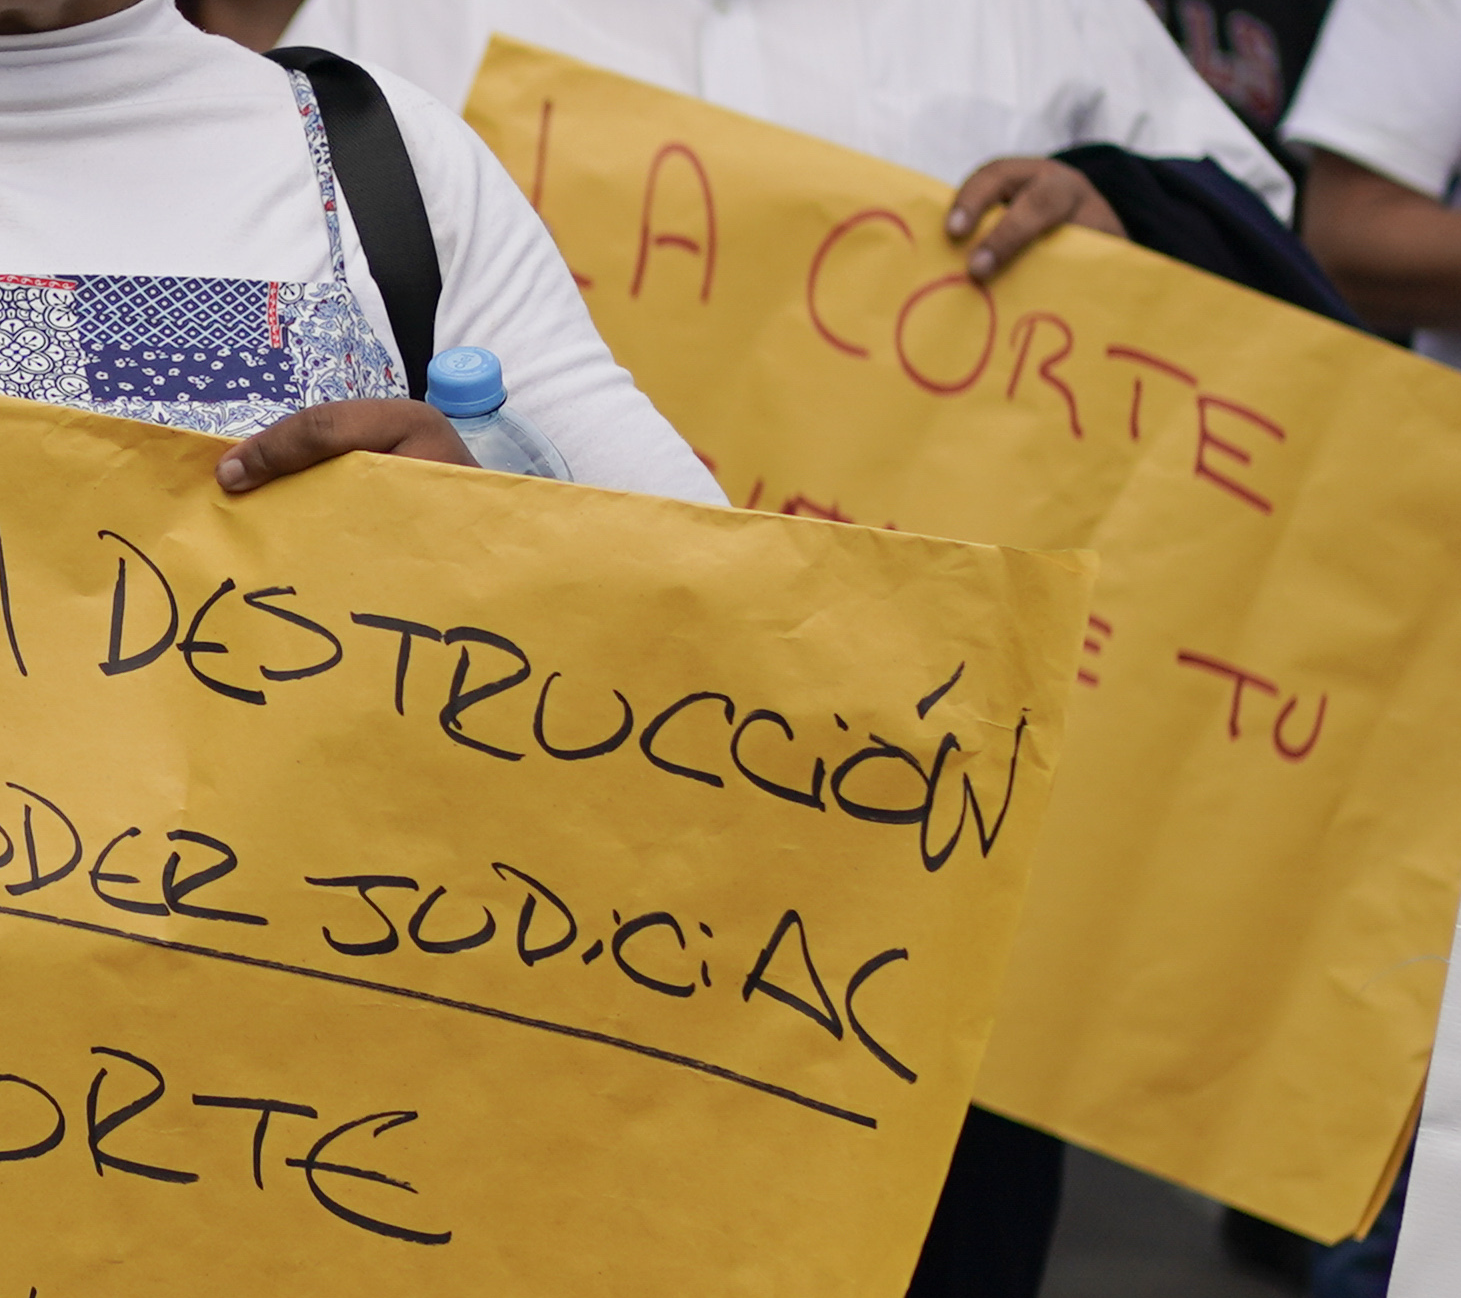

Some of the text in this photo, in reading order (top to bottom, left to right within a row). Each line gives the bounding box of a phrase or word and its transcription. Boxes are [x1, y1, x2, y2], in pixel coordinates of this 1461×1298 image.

[528, 98, 1288, 518] LA CORTE
[1174, 646, 1330, 766] TU
